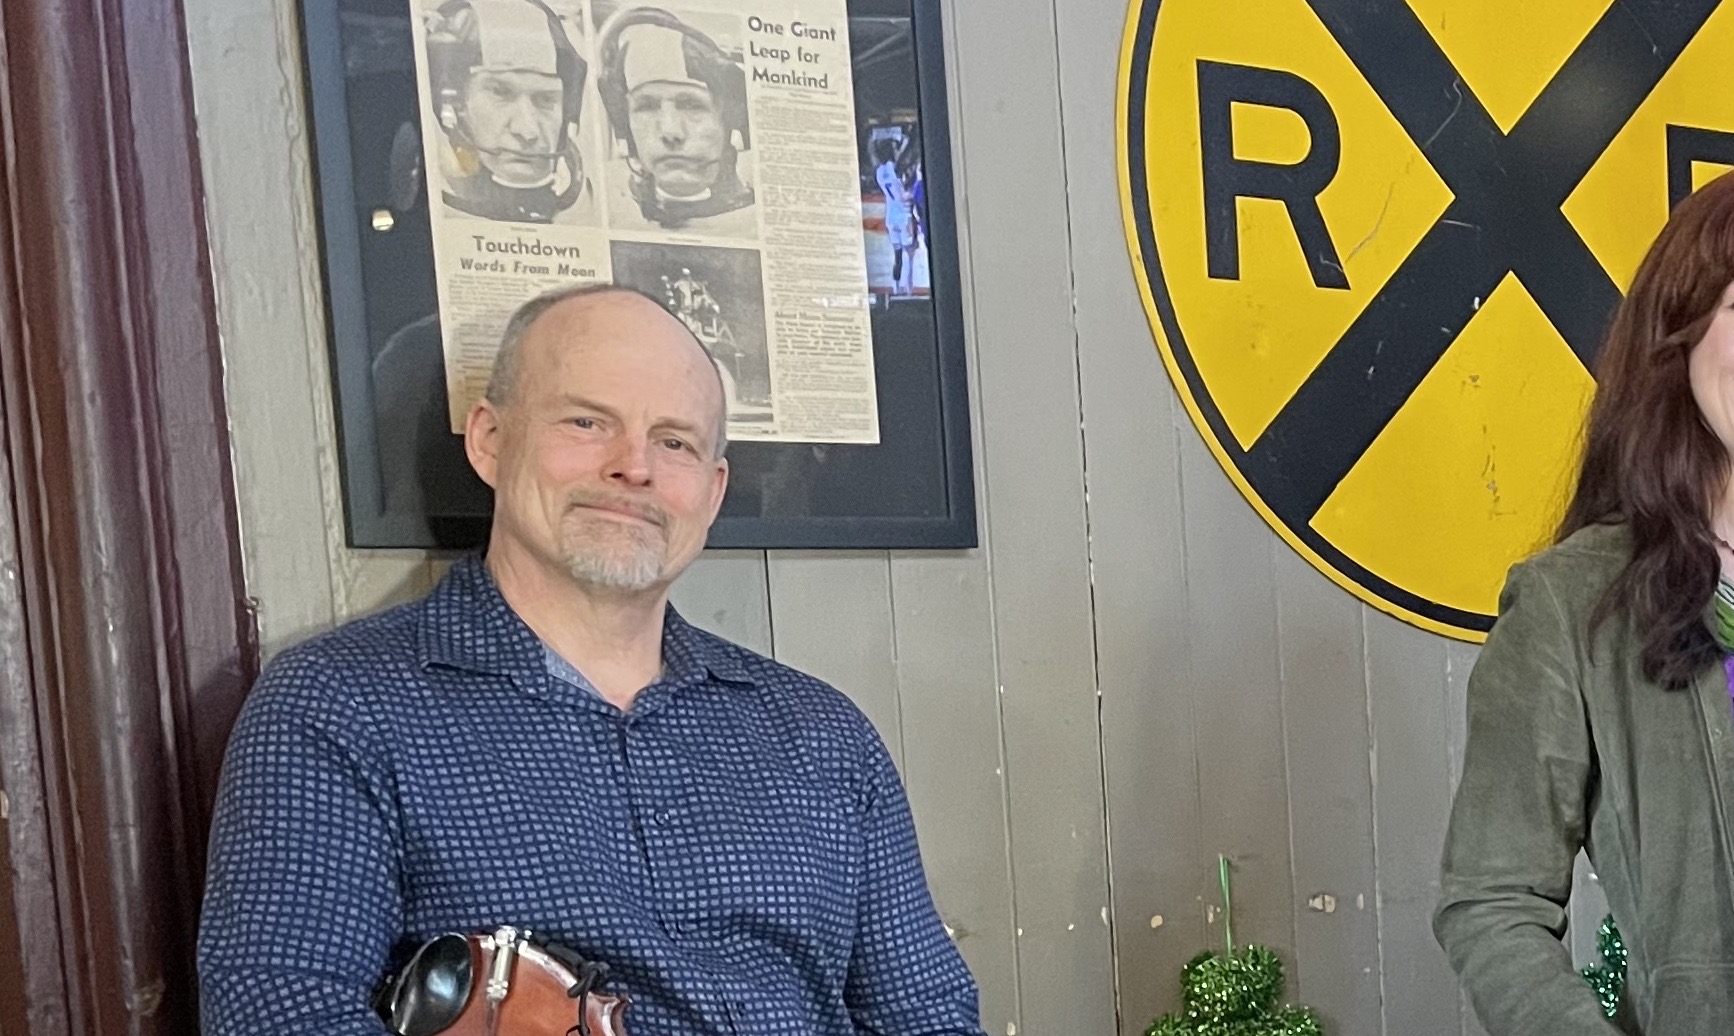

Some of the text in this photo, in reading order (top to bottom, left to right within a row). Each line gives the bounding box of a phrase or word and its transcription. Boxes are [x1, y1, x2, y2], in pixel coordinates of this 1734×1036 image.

[748, 16, 836, 41] One Giant
[750, 40, 820, 63] Leap for
[753, 66, 828, 89] Mankind
[1196, 59, 1351, 290] R
[472, 235, 580, 258] Touchdown
[460, 257, 595, 277] Words From Moon
